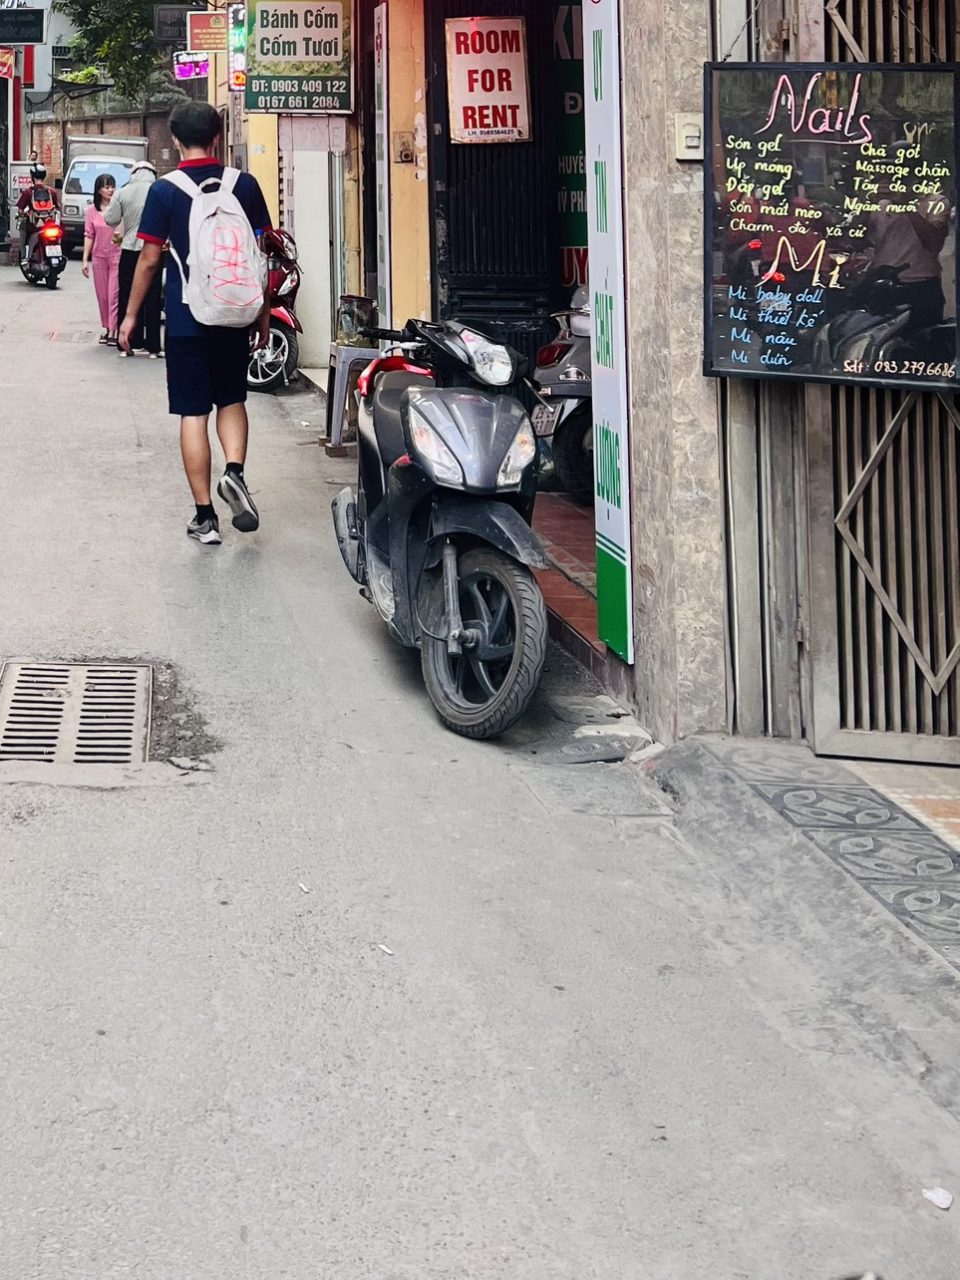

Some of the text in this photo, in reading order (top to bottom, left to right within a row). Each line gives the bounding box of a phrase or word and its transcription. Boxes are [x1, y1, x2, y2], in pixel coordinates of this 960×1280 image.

[260, 7, 338, 29] Bánh Cốm
[260, 34, 338, 57] Cốm Tươi
[455, 28, 521, 56] ROOM
[592, 29, 603, 102] UY
[252, 80, 346, 93] ĐT: 0903 409 122
[467, 67, 513, 94] FOR
[258, 95, 340, 109] 0167 661 2084
[754, 72, 872, 144] Nails
[462, 104, 520, 129] RENT
[758, 133, 784, 158] gel
[754, 157, 793, 180] móng
[855, 159, 910, 180] Massage
[594, 144, 608, 234] TÍN
[762, 179, 787, 200] gel
[888, 180, 907, 193] da
[795, 204, 823, 219] mèo
[730, 218, 775, 232] Charm
[755, 236, 846, 289] Mi
[728, 285, 825, 307] Mi baby doll
[593, 267, 615, 370] CHẤT
[730, 327, 752, 344] Mi
[731, 349, 751, 364] Mi
